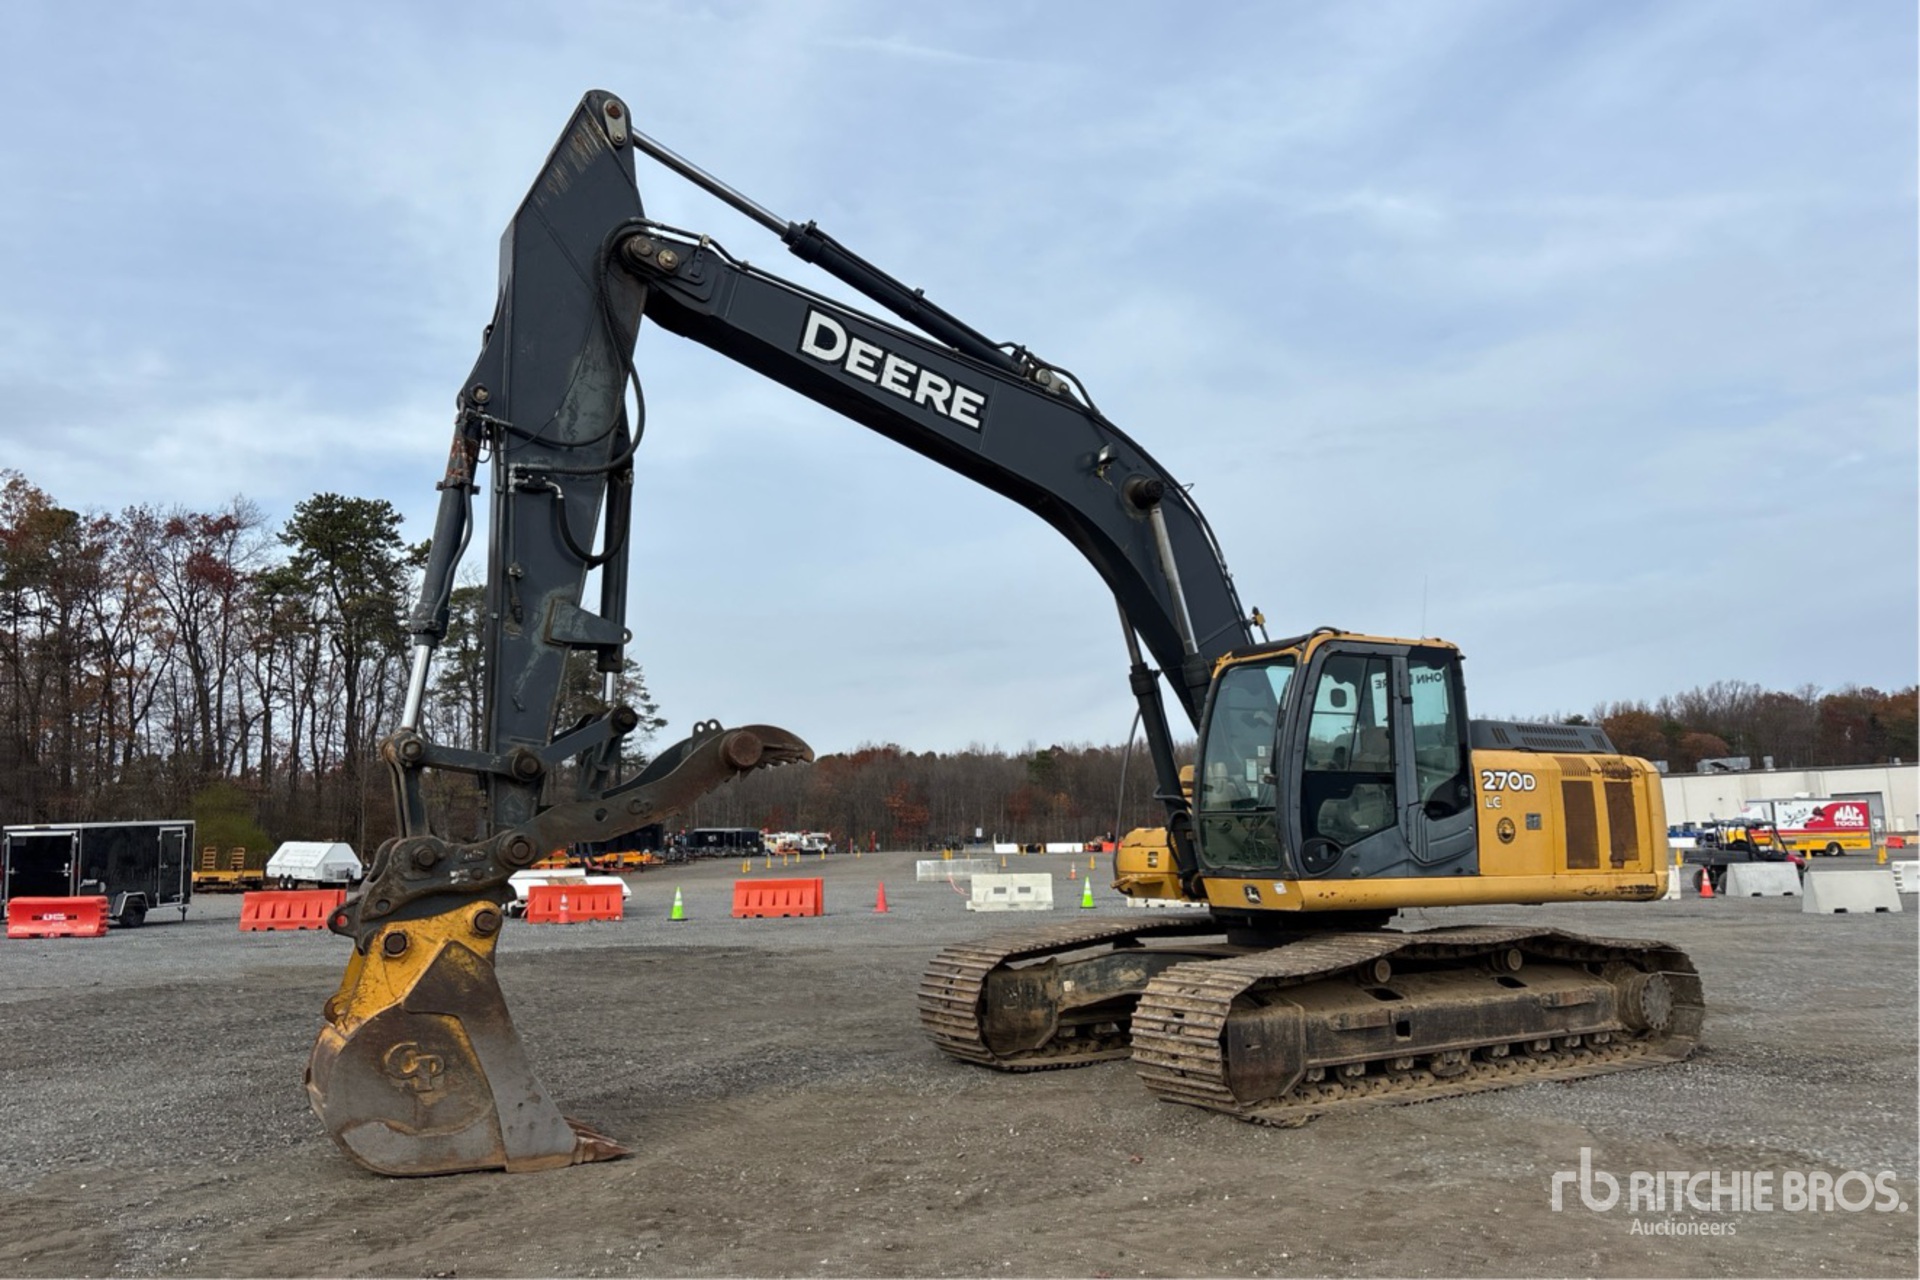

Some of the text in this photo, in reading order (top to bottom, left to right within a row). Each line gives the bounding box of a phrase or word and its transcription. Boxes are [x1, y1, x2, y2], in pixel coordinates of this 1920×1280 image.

[800, 309, 986, 429] DEERE
[1481, 770, 1537, 791] 270D
[1485, 796, 1502, 808] LC
[1834, 804, 1864, 819] MAC
[1834, 819, 1864, 827] TOOLS
